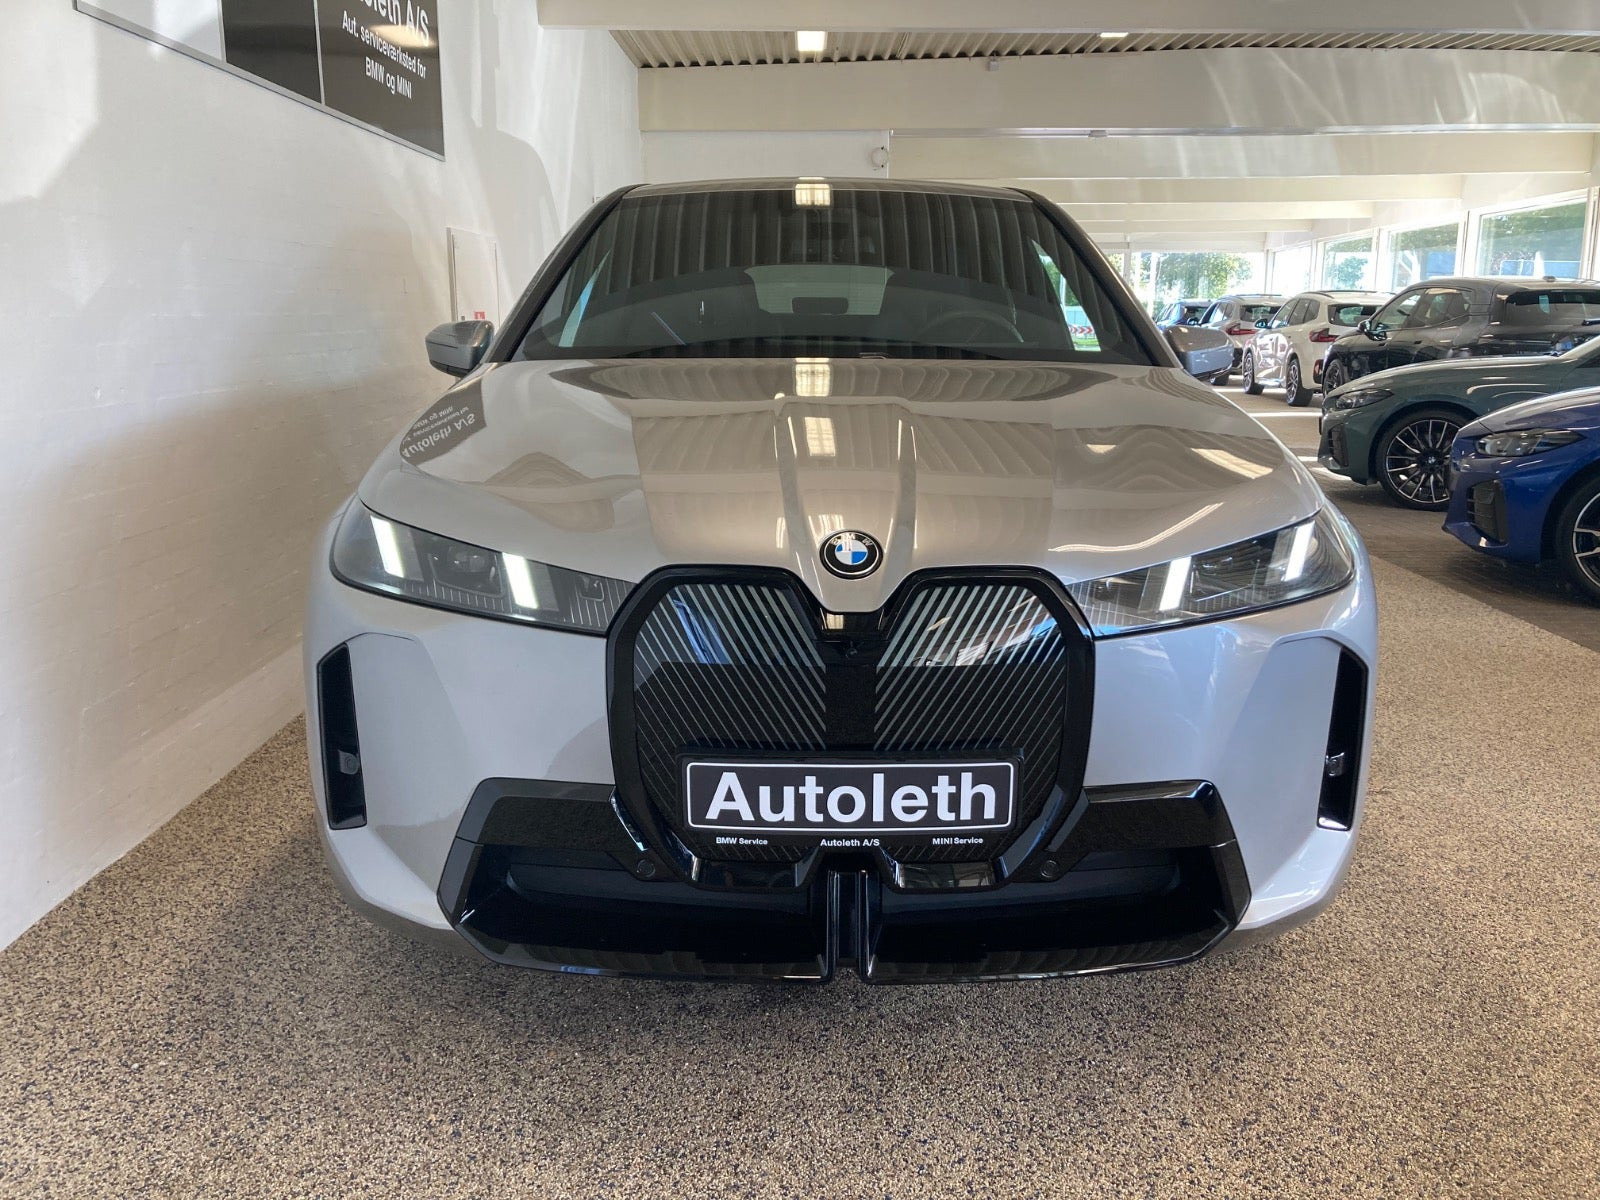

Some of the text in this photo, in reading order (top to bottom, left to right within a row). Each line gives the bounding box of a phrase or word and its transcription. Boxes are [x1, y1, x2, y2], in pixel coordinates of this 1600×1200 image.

[342, 10, 427, 79] Aut. serviceværksted for
[365, 56, 412, 99] BMW og MINI
[705, 771, 996, 823] Autoleth
[715, 836, 768, 845] BMW Service
[820, 838, 880, 847] Autoleth A/S
[932, 836, 984, 845] MINI Service
